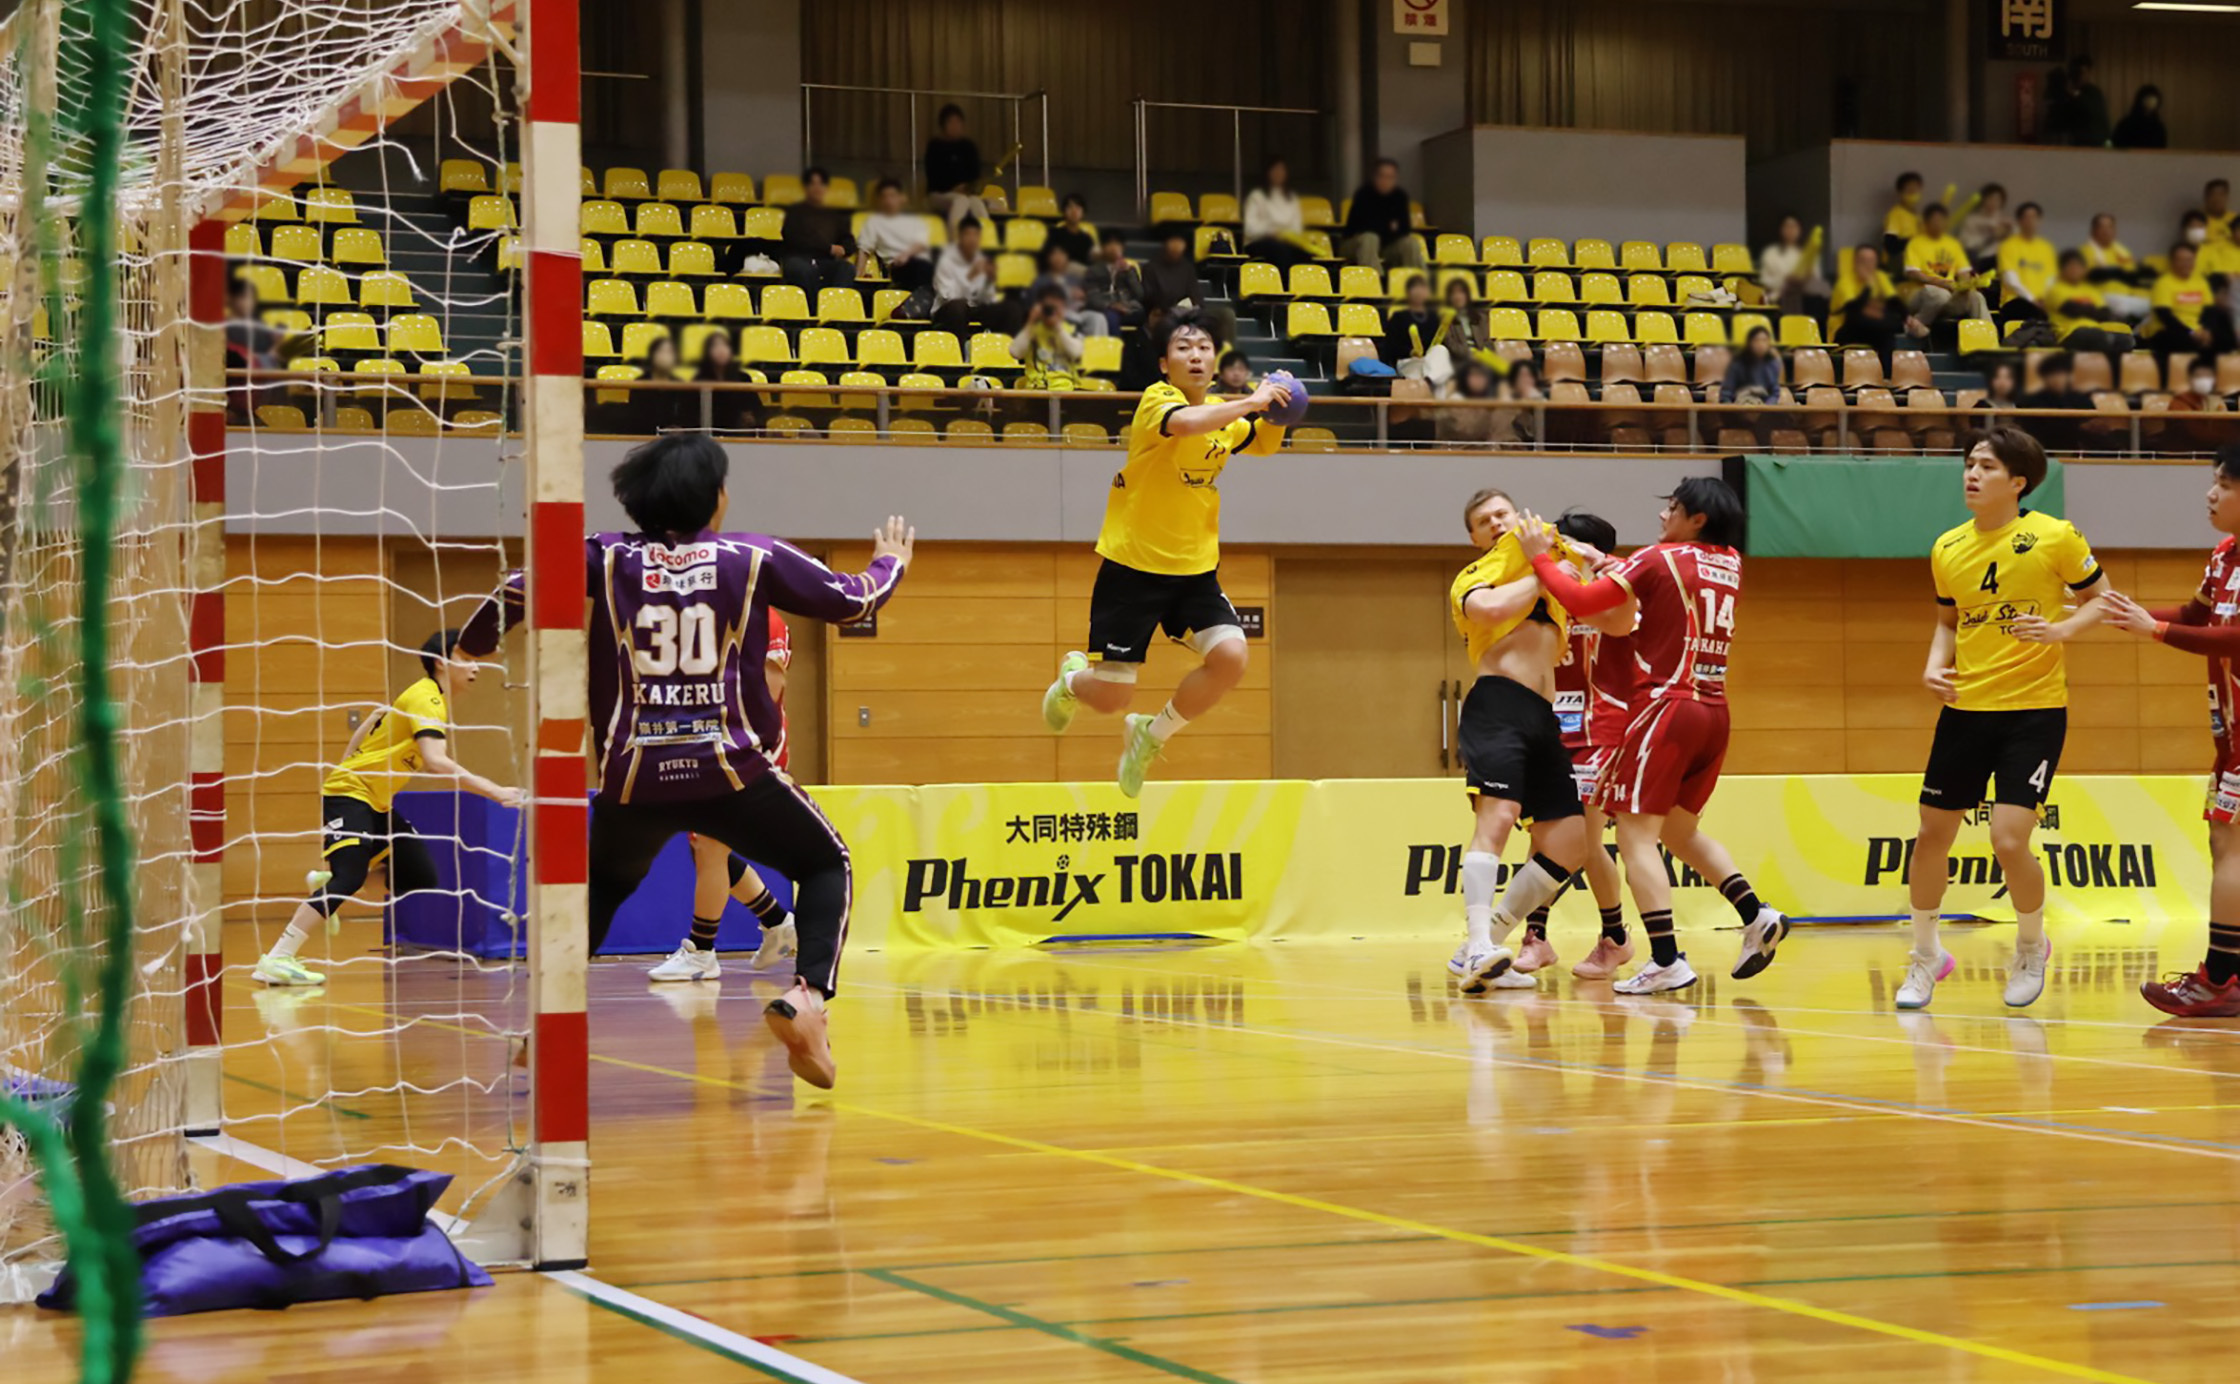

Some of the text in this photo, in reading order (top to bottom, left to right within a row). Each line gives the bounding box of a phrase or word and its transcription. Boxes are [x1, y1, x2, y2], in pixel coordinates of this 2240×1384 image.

[2001, 0, 2052, 38] 南
[1979, 561, 1999, 595] 4
[1700, 588, 1735, 637] 14
[634, 602, 719, 677] 30
[632, 682, 726, 706] KAKERU
[2028, 760, 2048, 793] 4
[1005, 812, 1138, 844] 大同特殊鋼
[2043, 843, 2156, 888] TOKAI
[903, 852, 1242, 922] Phenix TOKAI
